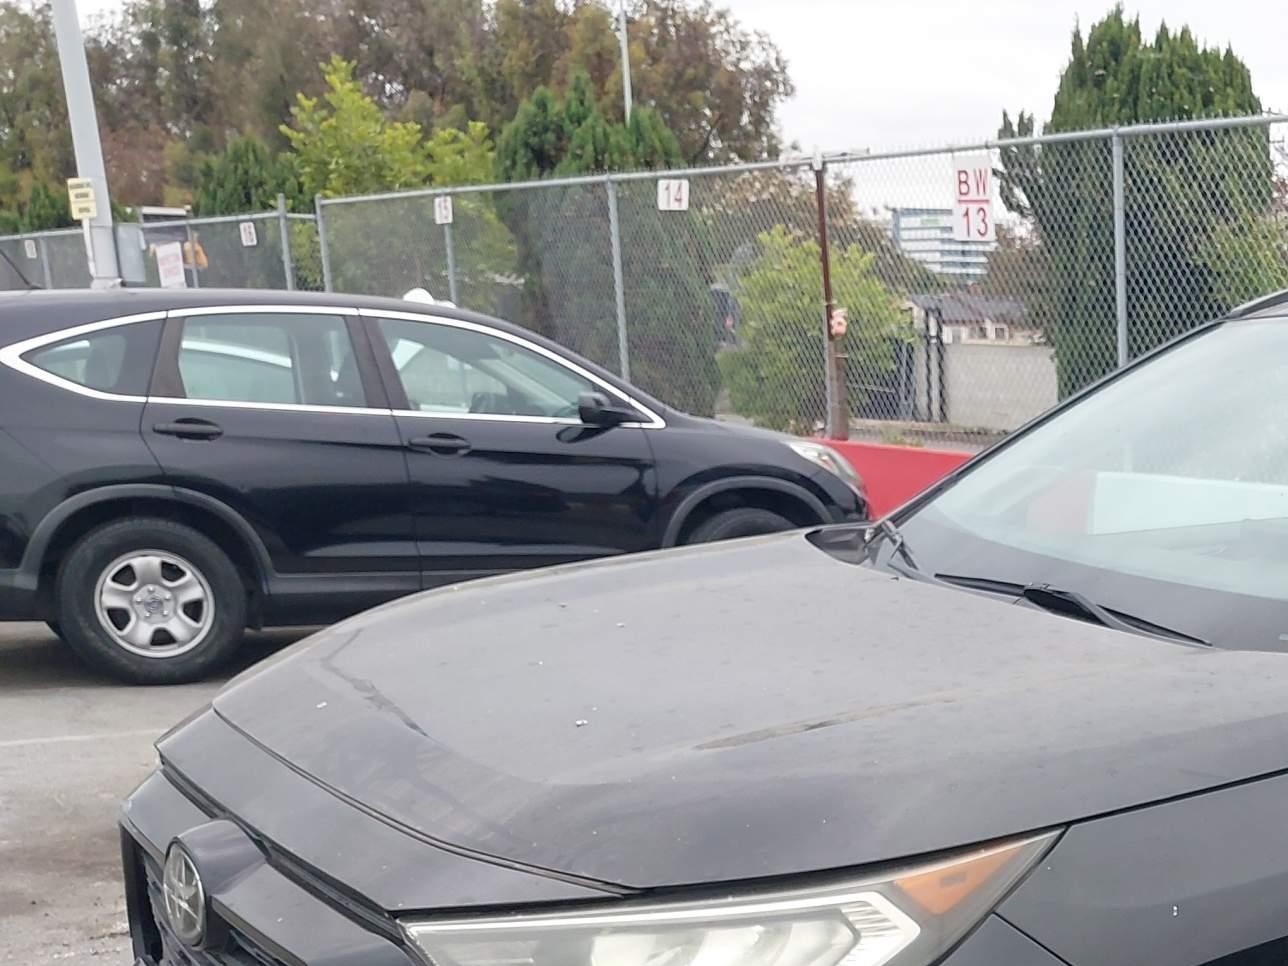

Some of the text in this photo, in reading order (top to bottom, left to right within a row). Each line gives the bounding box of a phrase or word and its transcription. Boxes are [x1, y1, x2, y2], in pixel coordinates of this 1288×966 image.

[664, 181, 683, 208] 14
[957, 169, 988, 196] BW
[963, 207, 988, 237] 13
